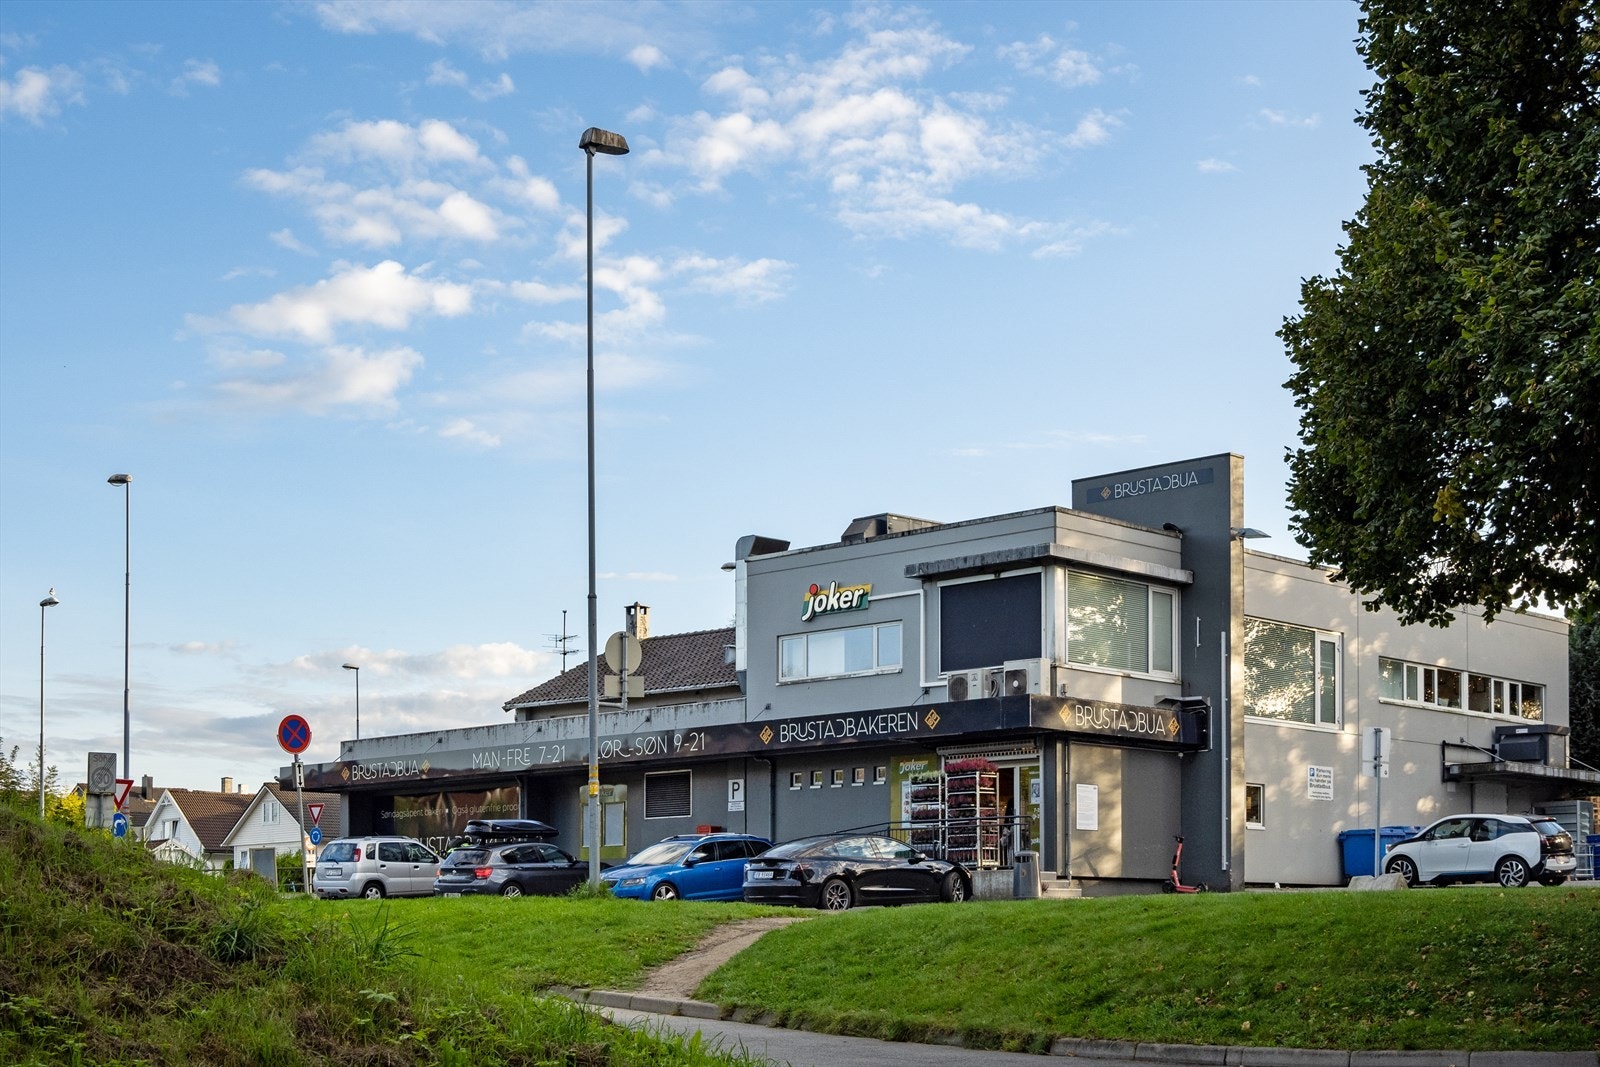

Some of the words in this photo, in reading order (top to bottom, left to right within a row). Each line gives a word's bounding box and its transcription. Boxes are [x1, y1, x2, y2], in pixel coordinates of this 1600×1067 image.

[1114, 471, 1198, 499] BRUSTADBUA
[801, 581, 865, 622] joker
[779, 711, 919, 744] BRUSTADBAKEREN
[1075, 704, 1166, 735] BRUSTADBUA
[472, 747, 530, 770] MAN-FRE
[538, 744, 566, 764] 7-21
[598, 735, 667, 759] ØR-SØN
[673, 732, 705, 753] 9-21
[352, 759, 419, 781] BRUSTADBUA
[899, 758, 926, 774] joker
[732, 781, 740, 800] P
